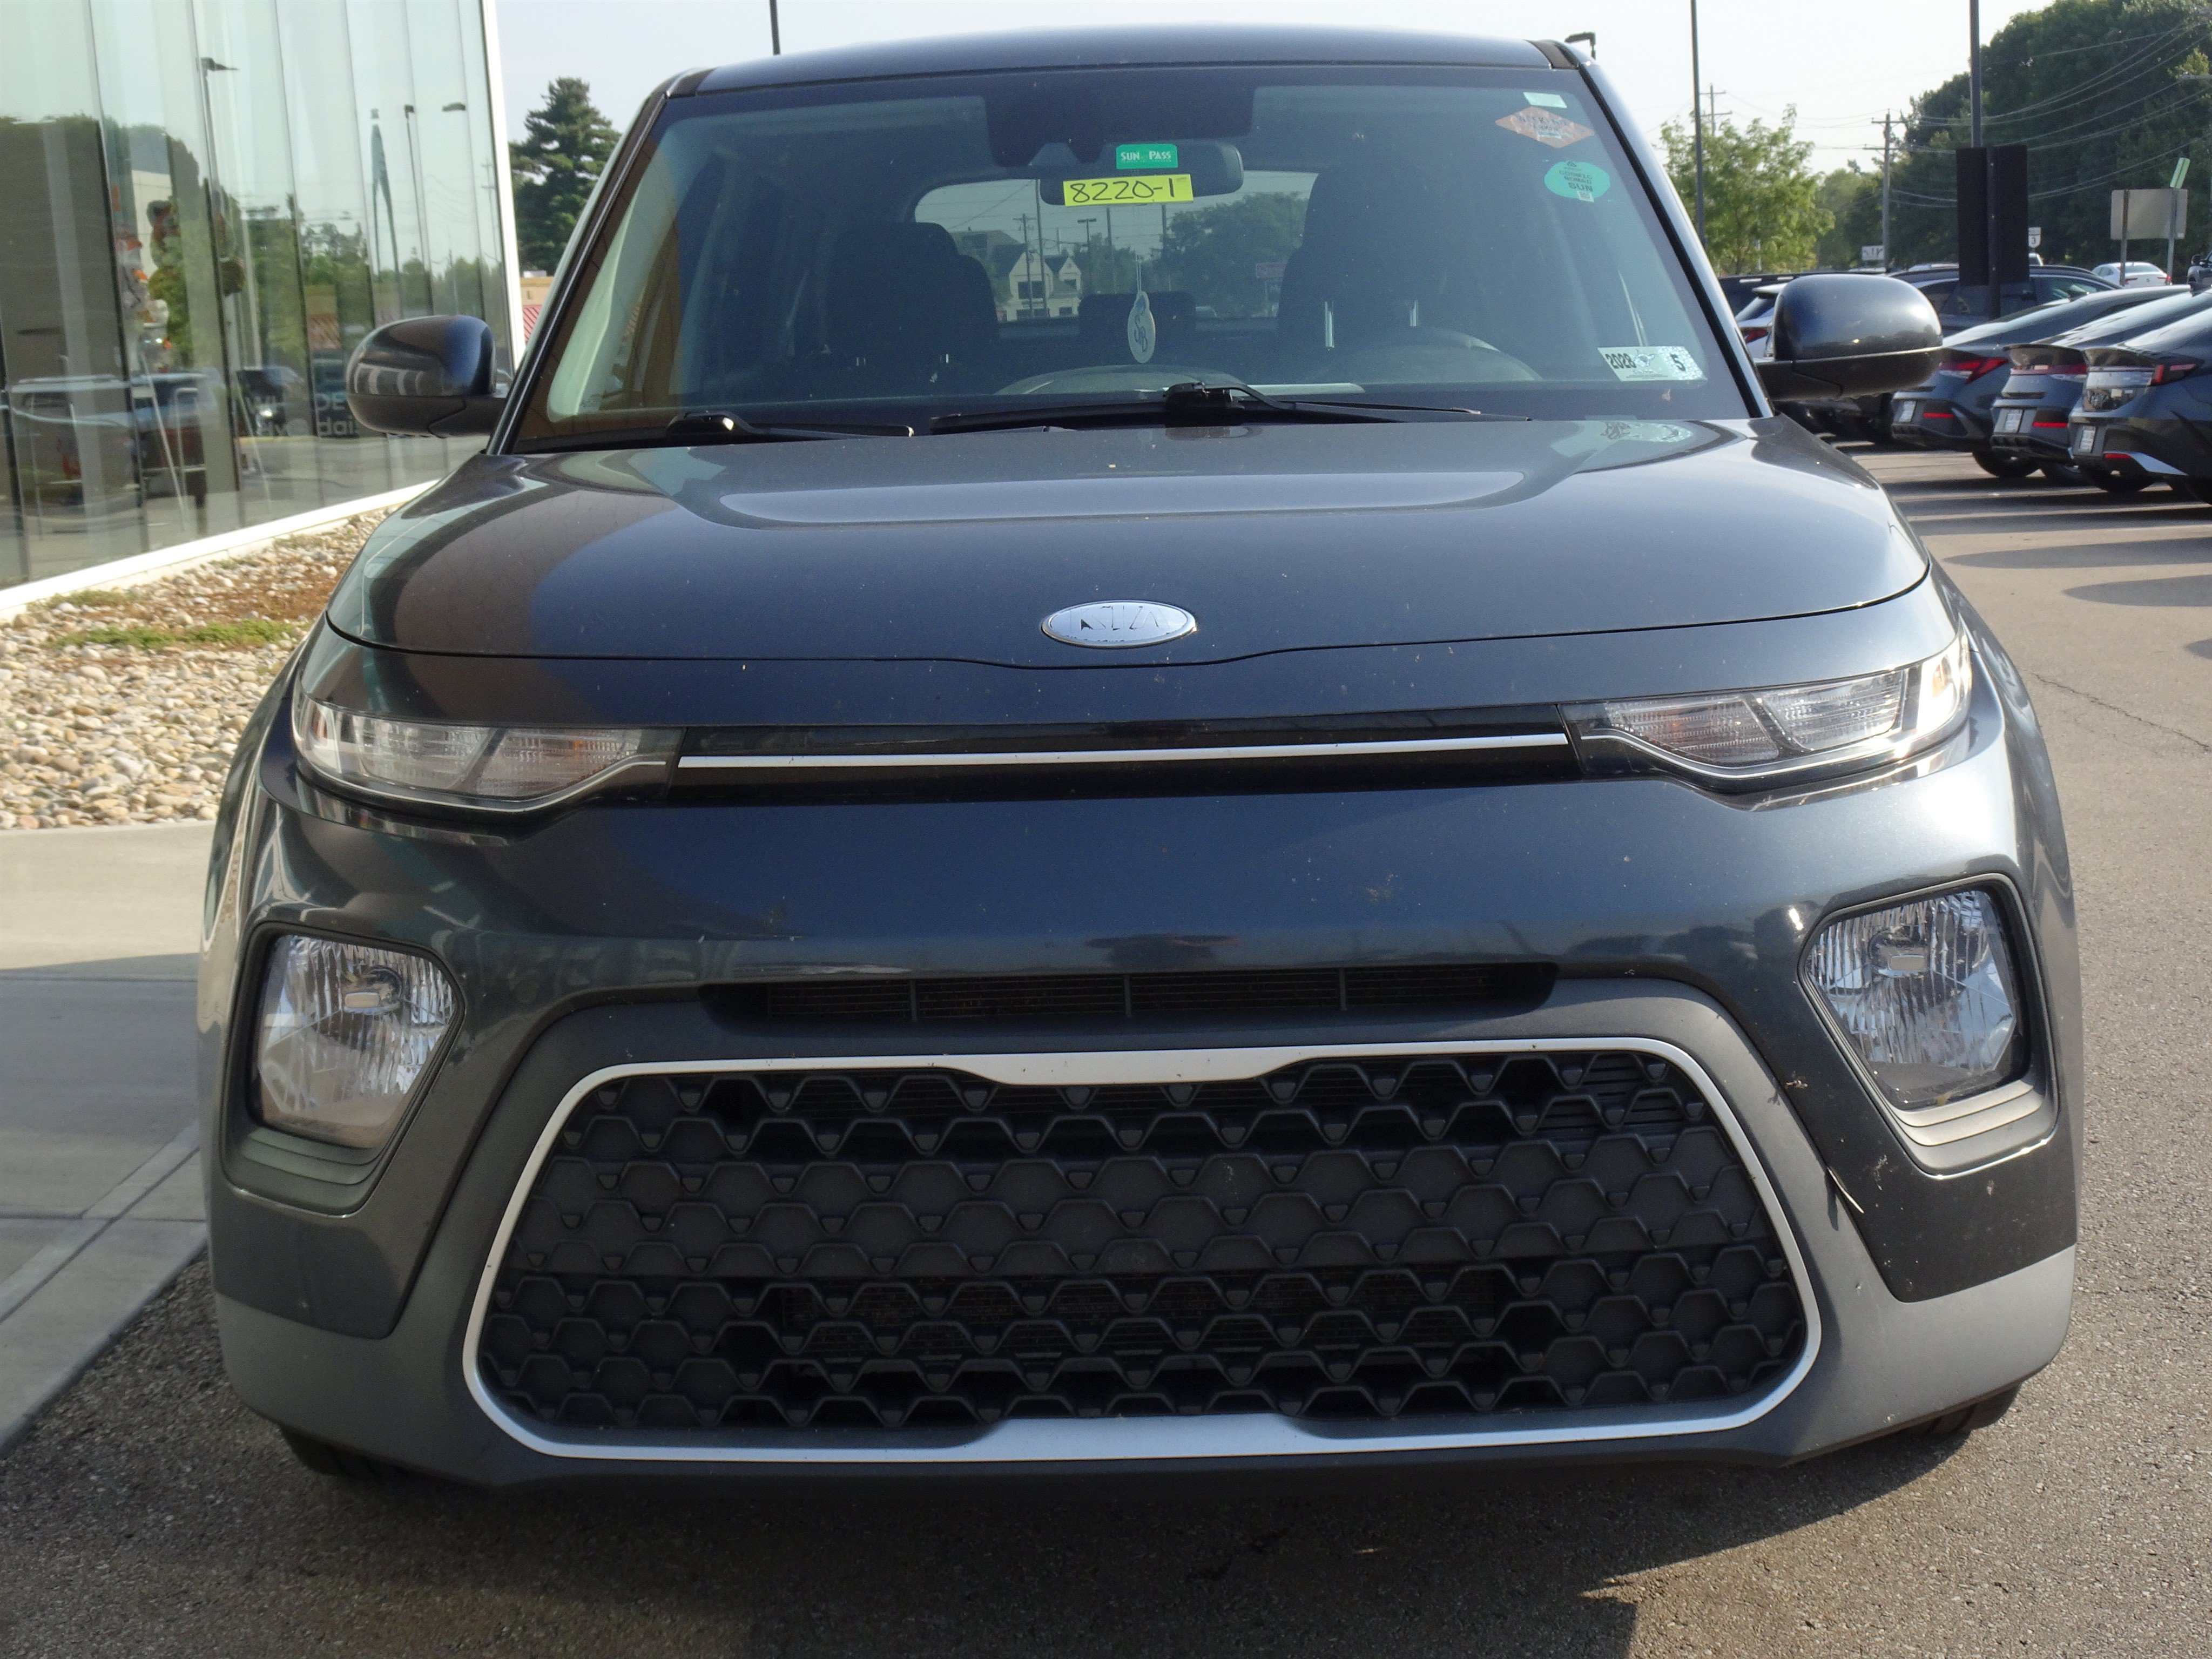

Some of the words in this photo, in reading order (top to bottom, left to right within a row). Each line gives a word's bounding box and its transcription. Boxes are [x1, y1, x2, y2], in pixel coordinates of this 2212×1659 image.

[1121, 152, 1140, 161] SUN
[1149, 151, 1171, 160] PASS
[1070, 177, 1175, 203] 8220-1
[1568, 182, 1594, 192] SUN
[1670, 354, 1686, 372] 5
[1069, 605, 1171, 631] KIA
